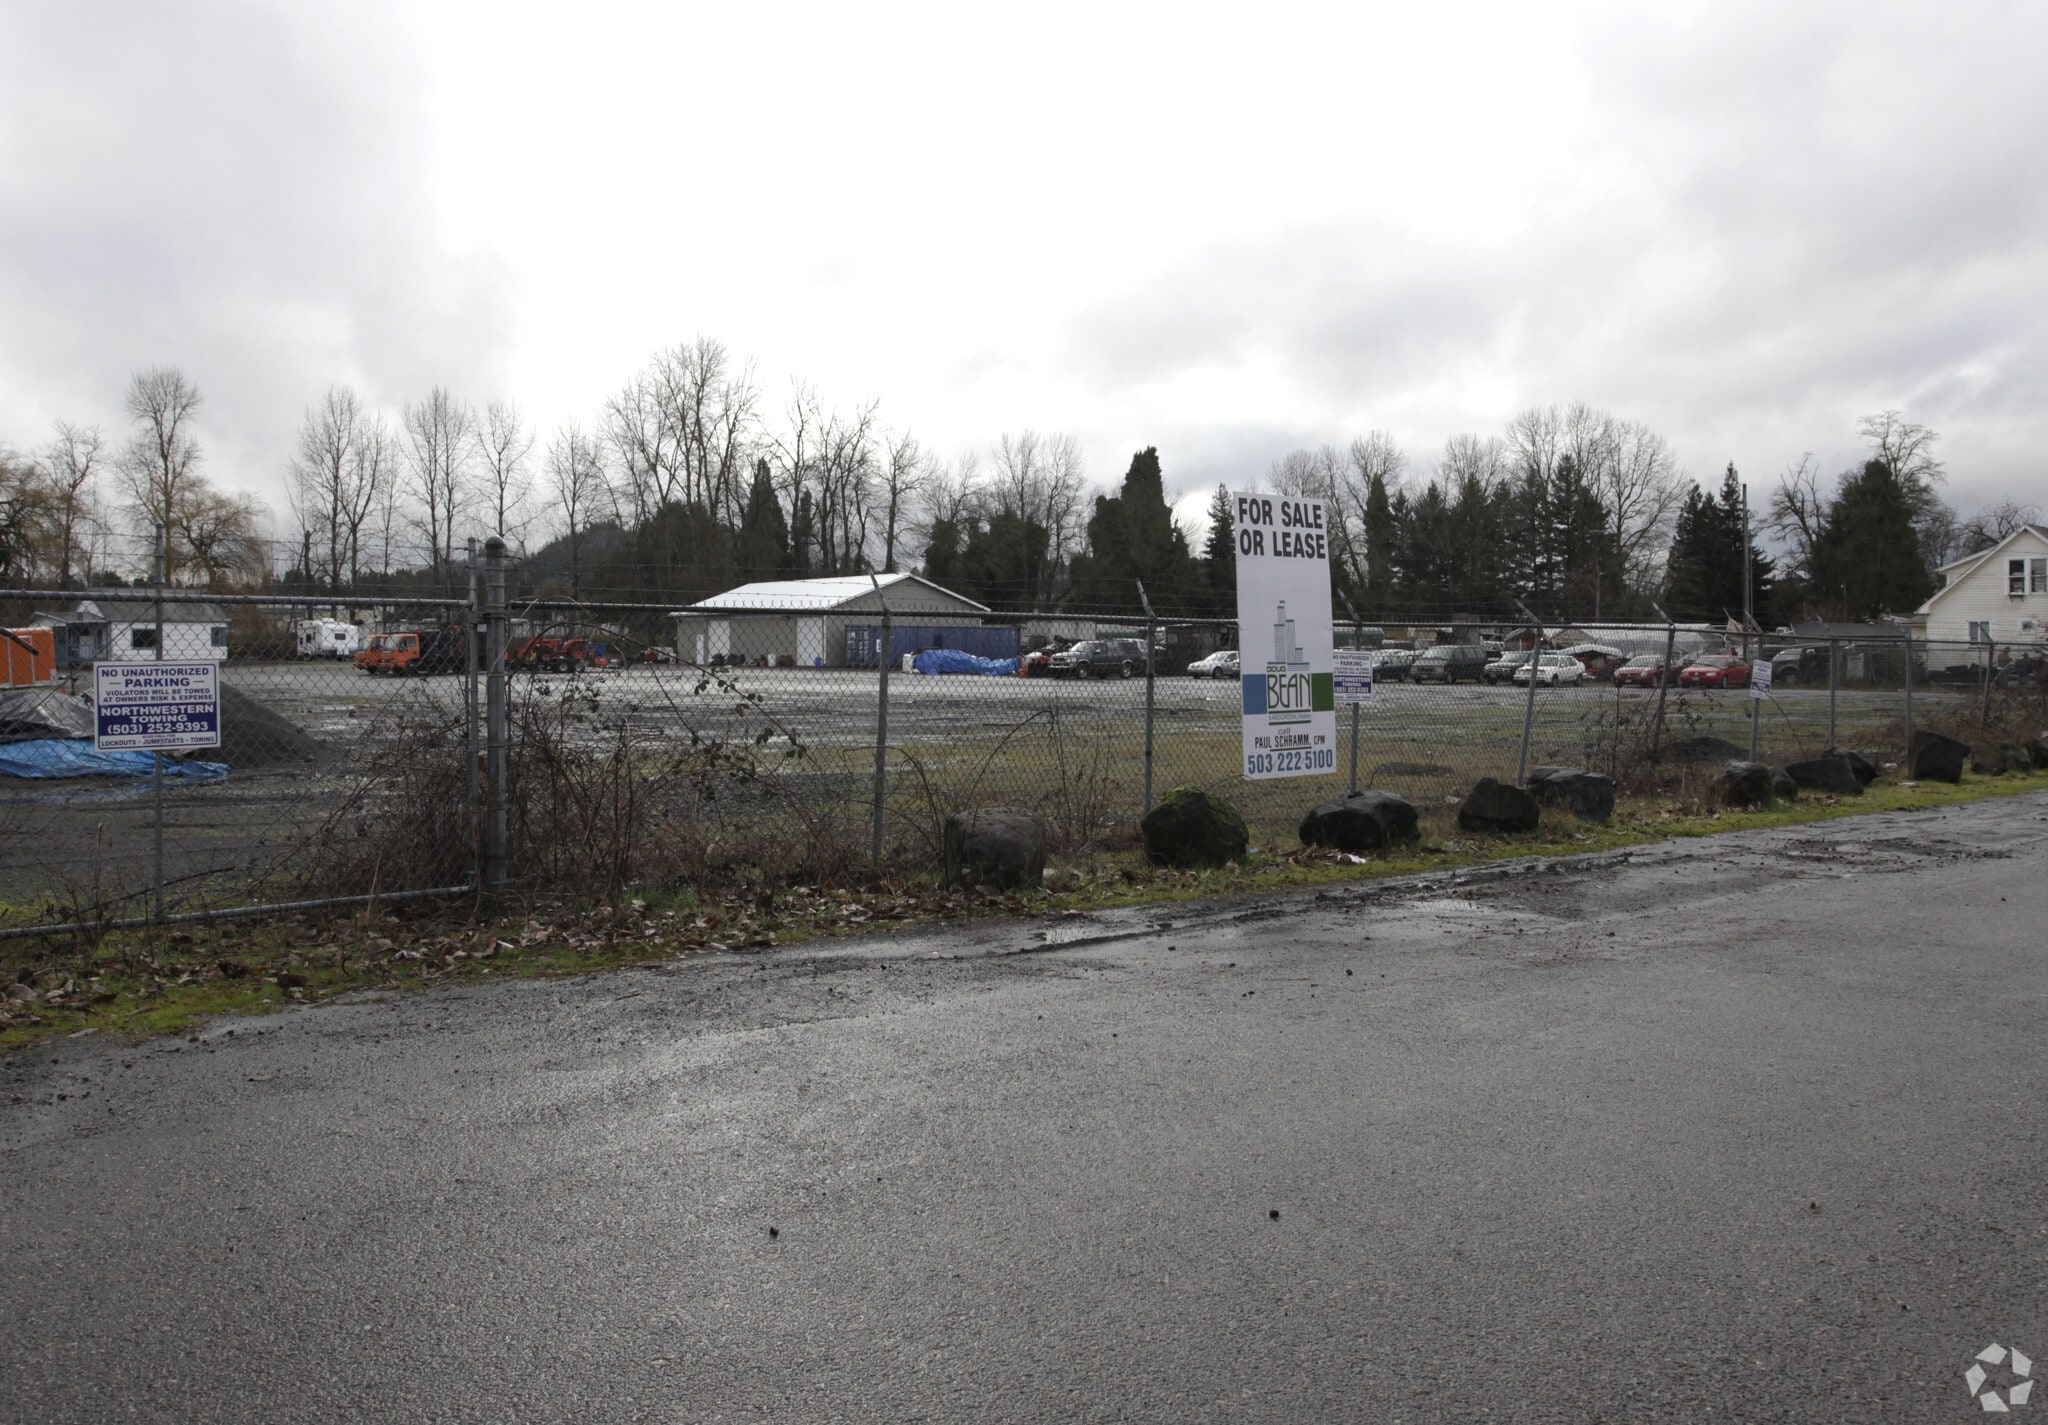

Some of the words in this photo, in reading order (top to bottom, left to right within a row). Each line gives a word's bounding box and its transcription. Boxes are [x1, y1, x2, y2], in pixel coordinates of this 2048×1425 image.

[1238, 497, 1273, 525] FOR
[1281, 501, 1323, 529] SALE
[1240, 528, 1264, 556] OR
[1272, 531, 1326, 559] LEASE
[102, 669, 118, 677] NO
[122, 668, 209, 676] UNAUTHORIZED
[125, 678, 190, 687] PARKING
[1267, 673, 1311, 709] BEAN
[101, 704, 214, 716] NORTHWESTERN
[130, 714, 188, 723] TOWING
[108, 724, 143, 734] (503)
[147, 722, 208, 733] 252-9393
[1255, 736, 1272, 749] PAUL
[1314, 735, 1325, 745] CPM
